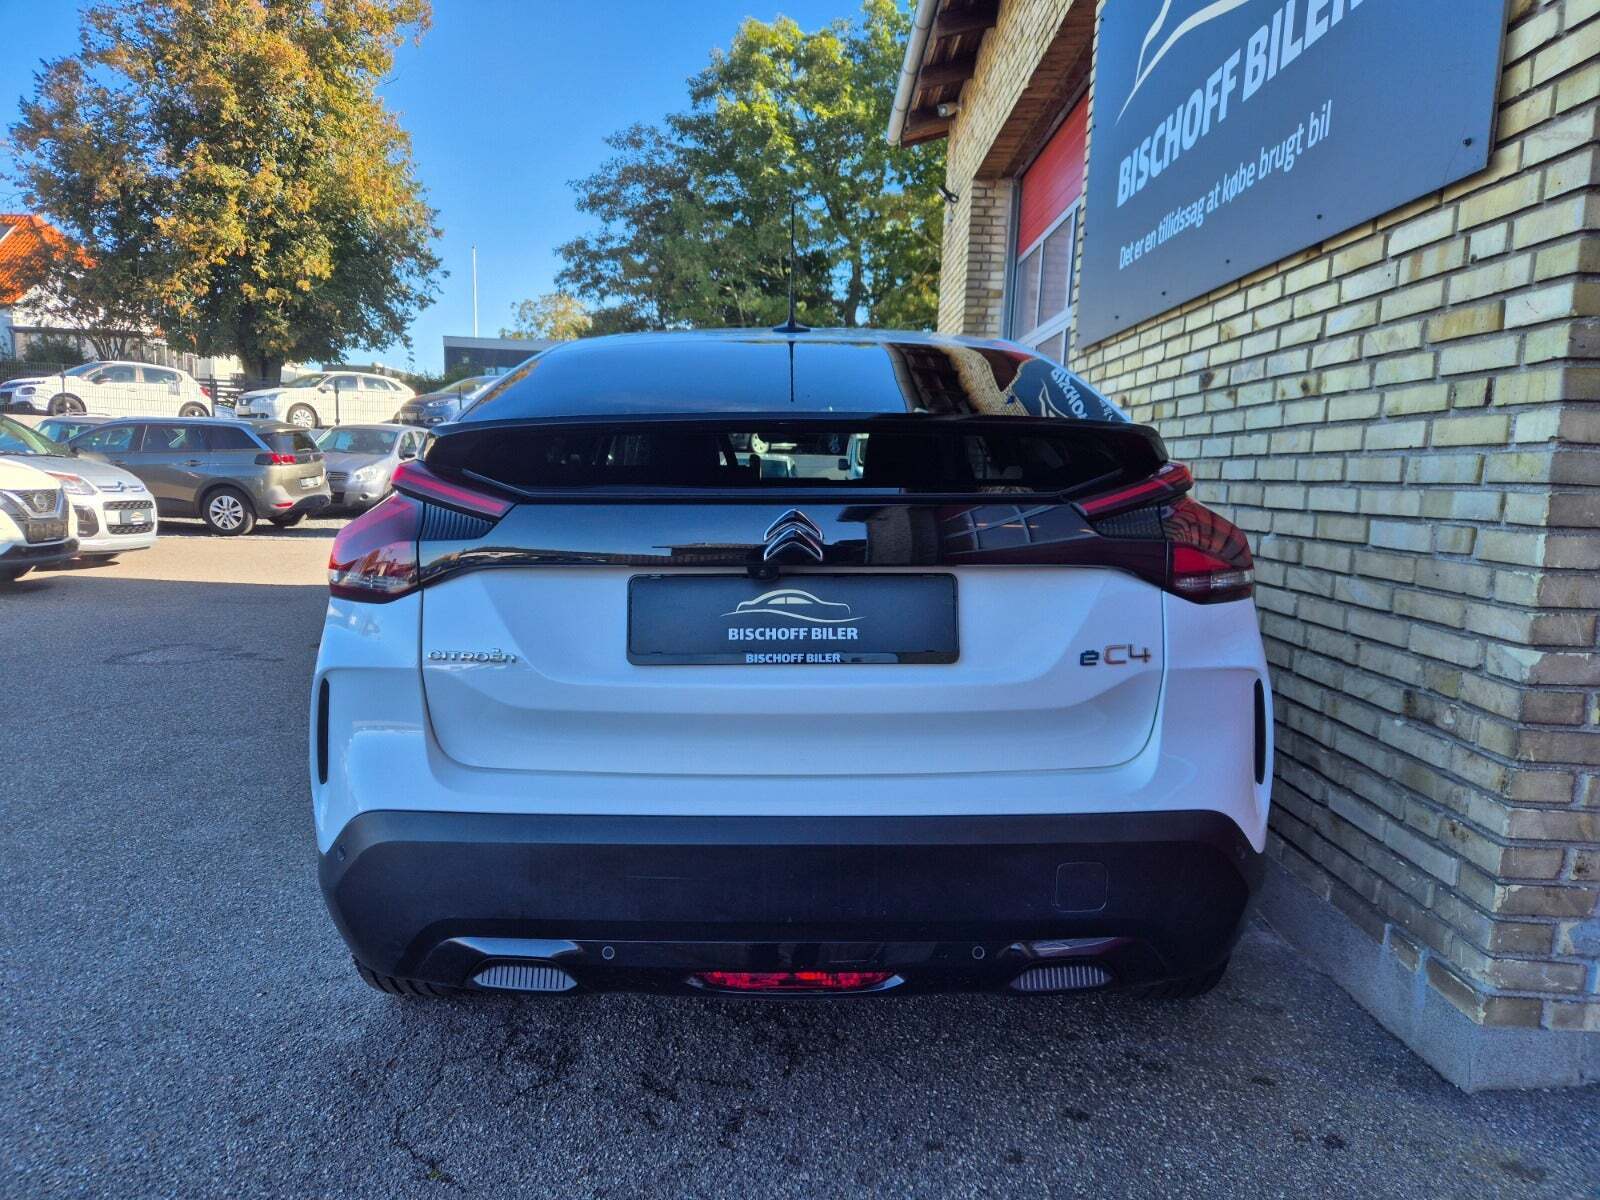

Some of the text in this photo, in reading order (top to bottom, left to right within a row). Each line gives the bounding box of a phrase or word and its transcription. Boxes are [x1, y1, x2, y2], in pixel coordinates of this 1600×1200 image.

[1117, 48, 1241, 208] BISCHOFF
[1119, 99, 1332, 271] Det er en tillidssag at købe brugt bil
[728, 627, 858, 641] BISCHOFF BILER
[745, 653, 840, 664] BISCHOFF BILER
